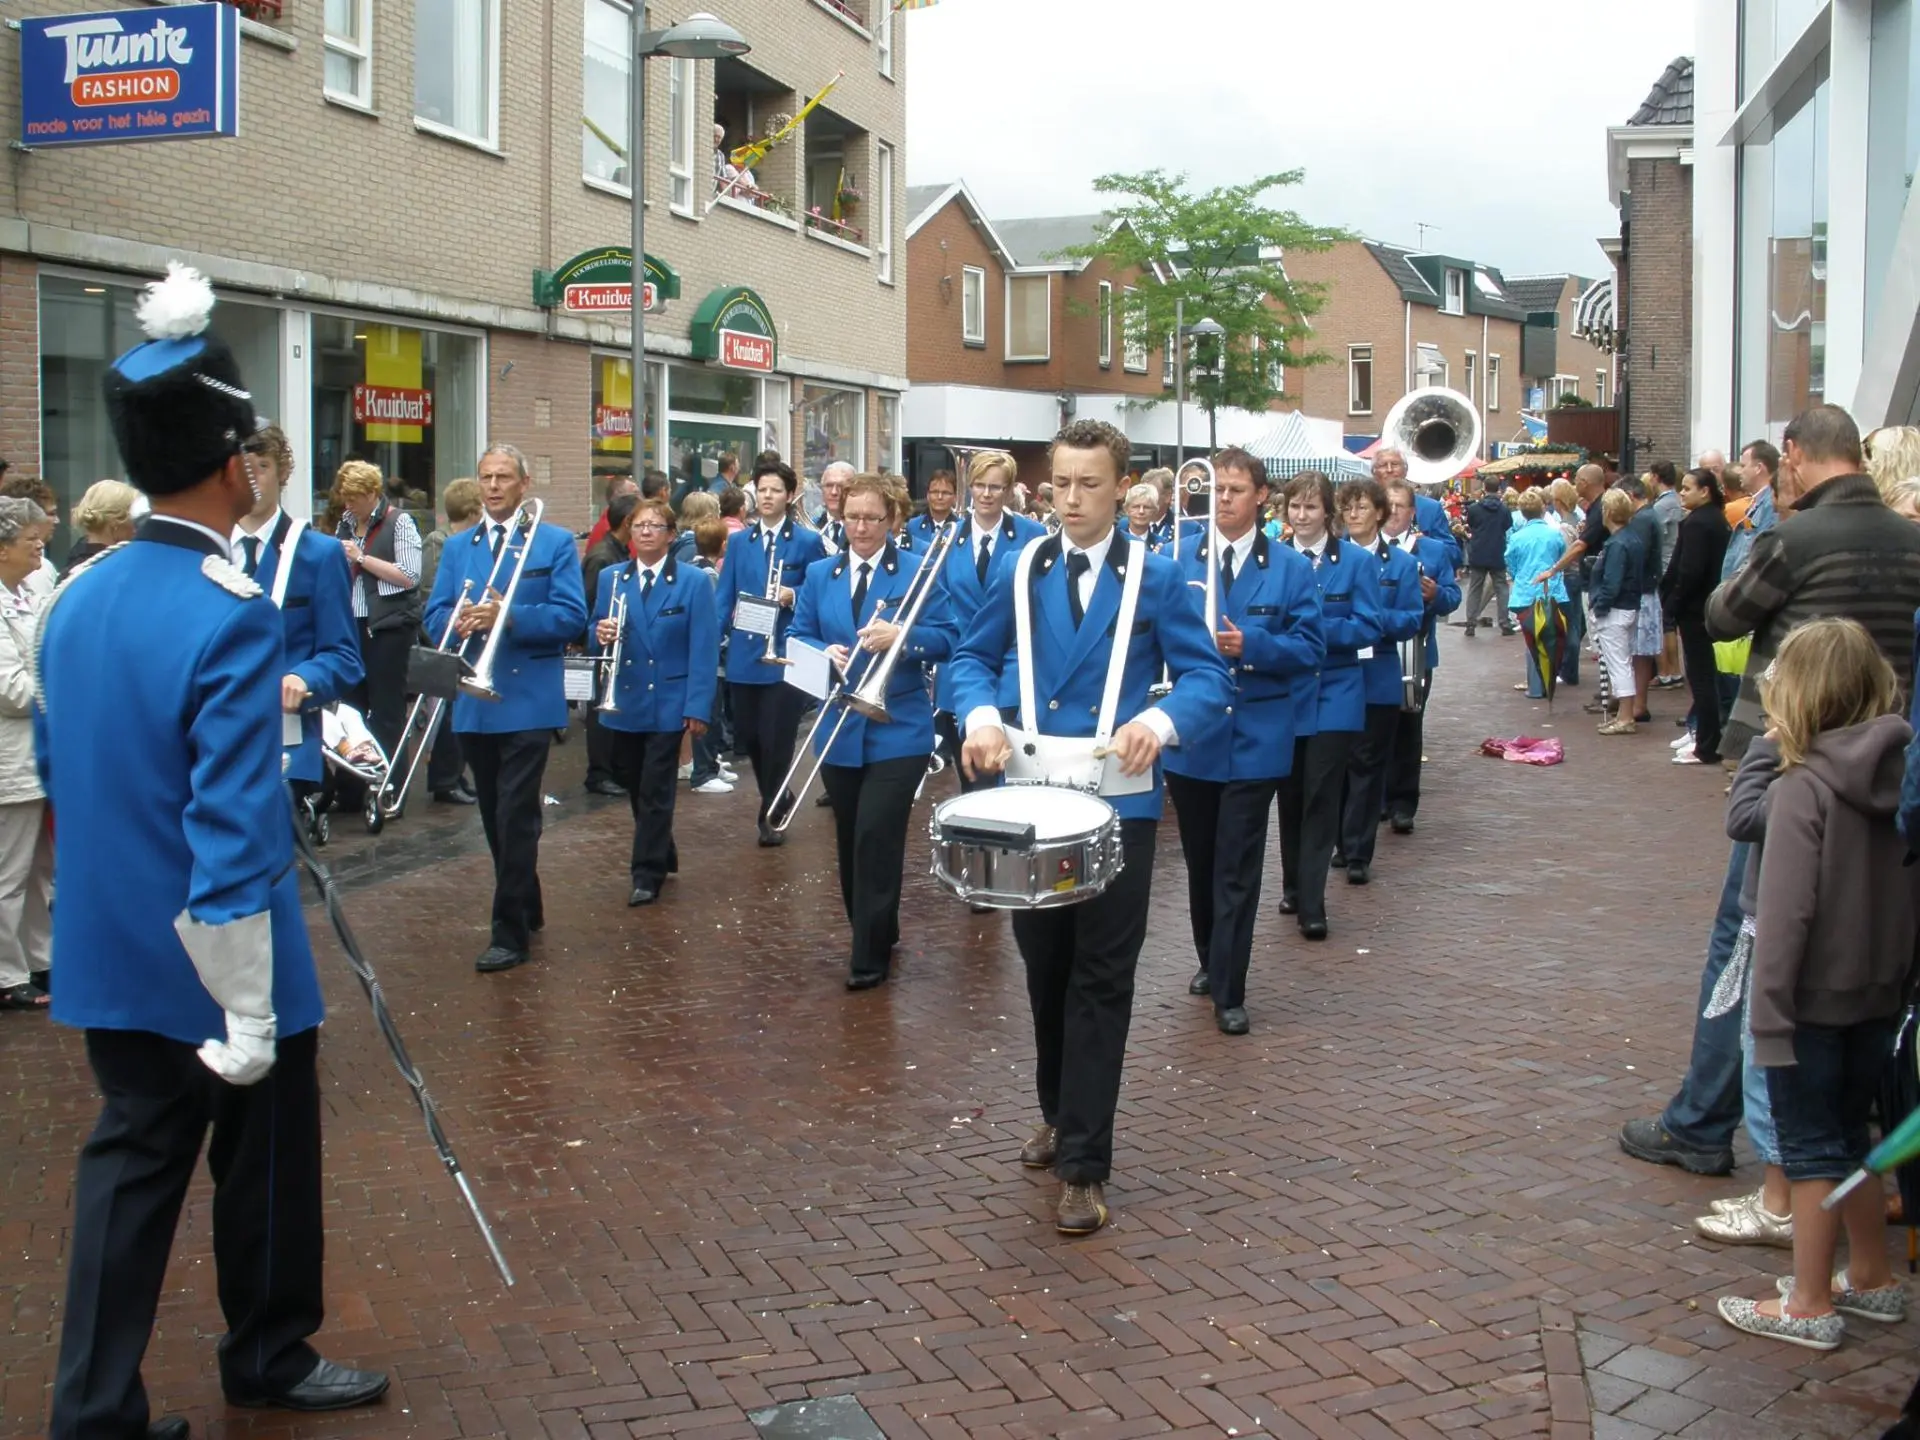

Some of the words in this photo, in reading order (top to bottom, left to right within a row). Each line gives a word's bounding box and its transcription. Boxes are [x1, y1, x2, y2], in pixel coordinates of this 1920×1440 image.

[43, 18, 193, 84] Tuunte
[81, 75, 170, 99] FASHION
[27, 118, 68, 134] mode
[72, 116, 103, 131] voor
[108, 112, 131, 129] het
[172, 108, 211, 128] gezin
[578, 289, 632, 306] Kruidva
[733, 338, 763, 363] Kruidvat
[365, 389, 424, 419] Kruidvat
